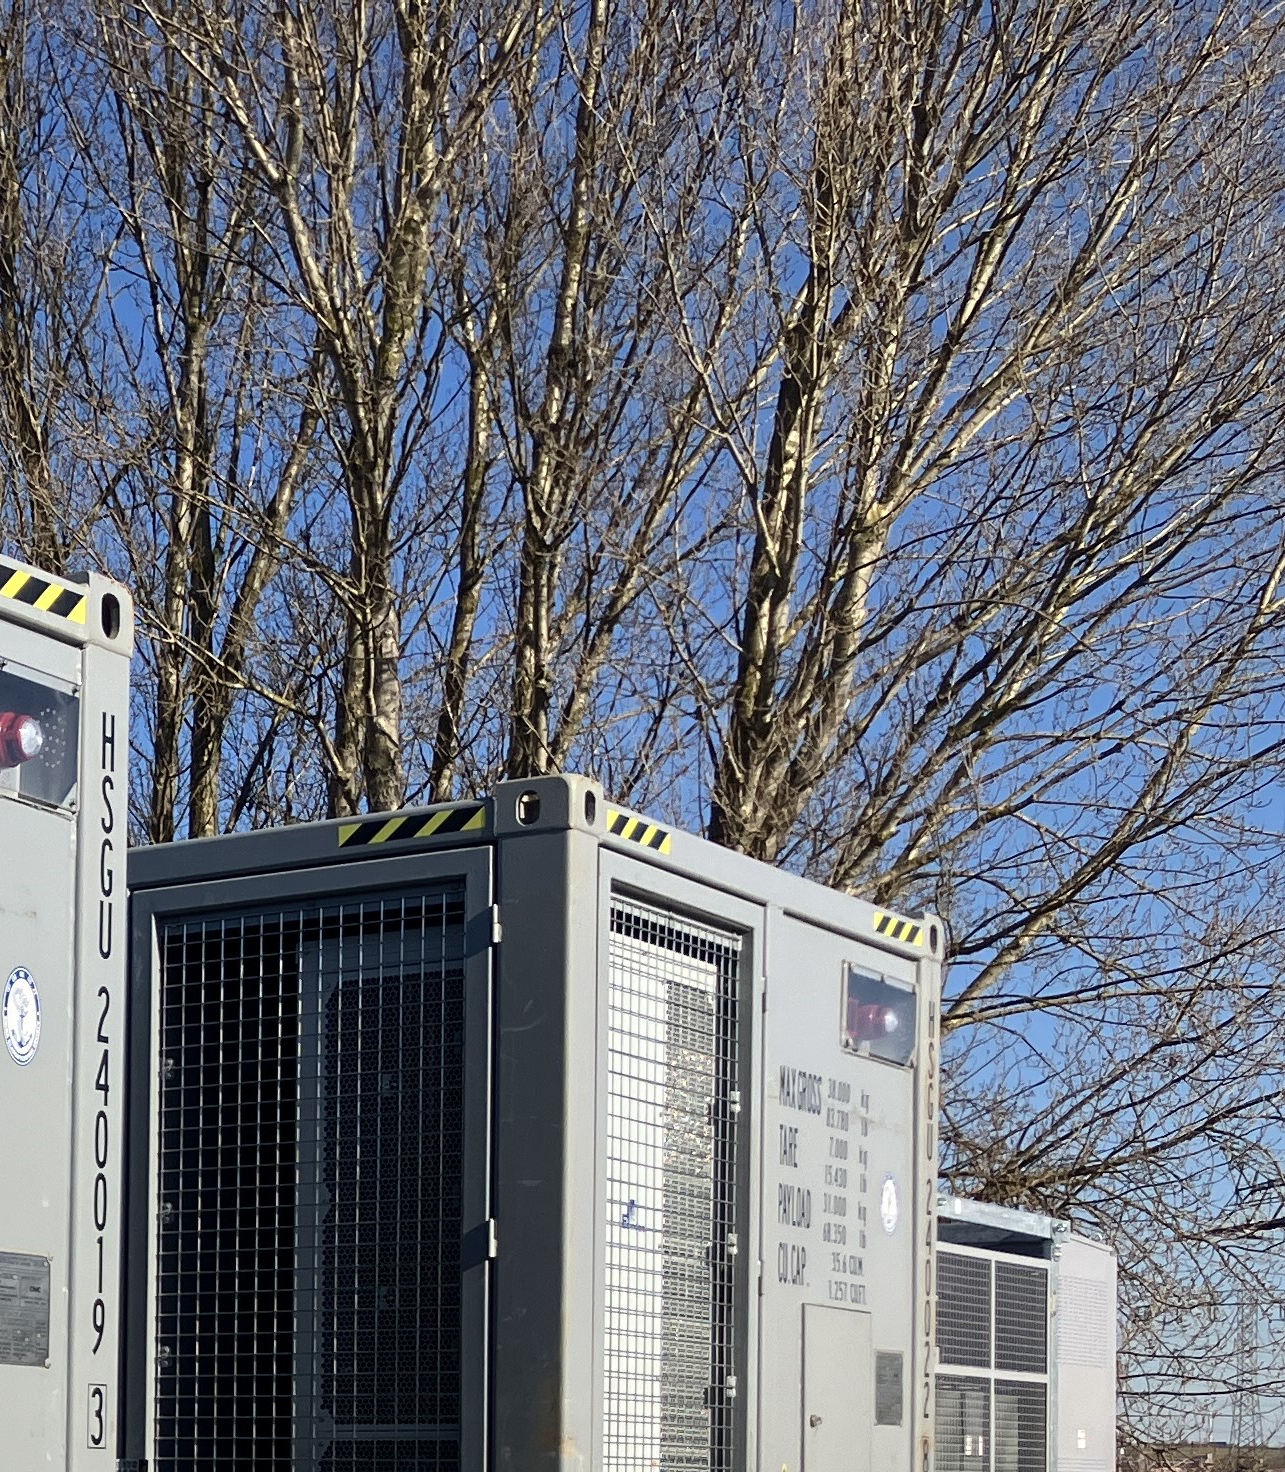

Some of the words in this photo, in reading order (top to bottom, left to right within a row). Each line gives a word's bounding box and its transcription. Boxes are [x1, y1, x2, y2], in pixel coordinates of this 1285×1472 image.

[98, 711, 116, 961] HSGU
[90, 985, 110, 1356] 240019
[779, 1123, 798, 1168] TARE
[90, 1385, 103, 1446] 3
